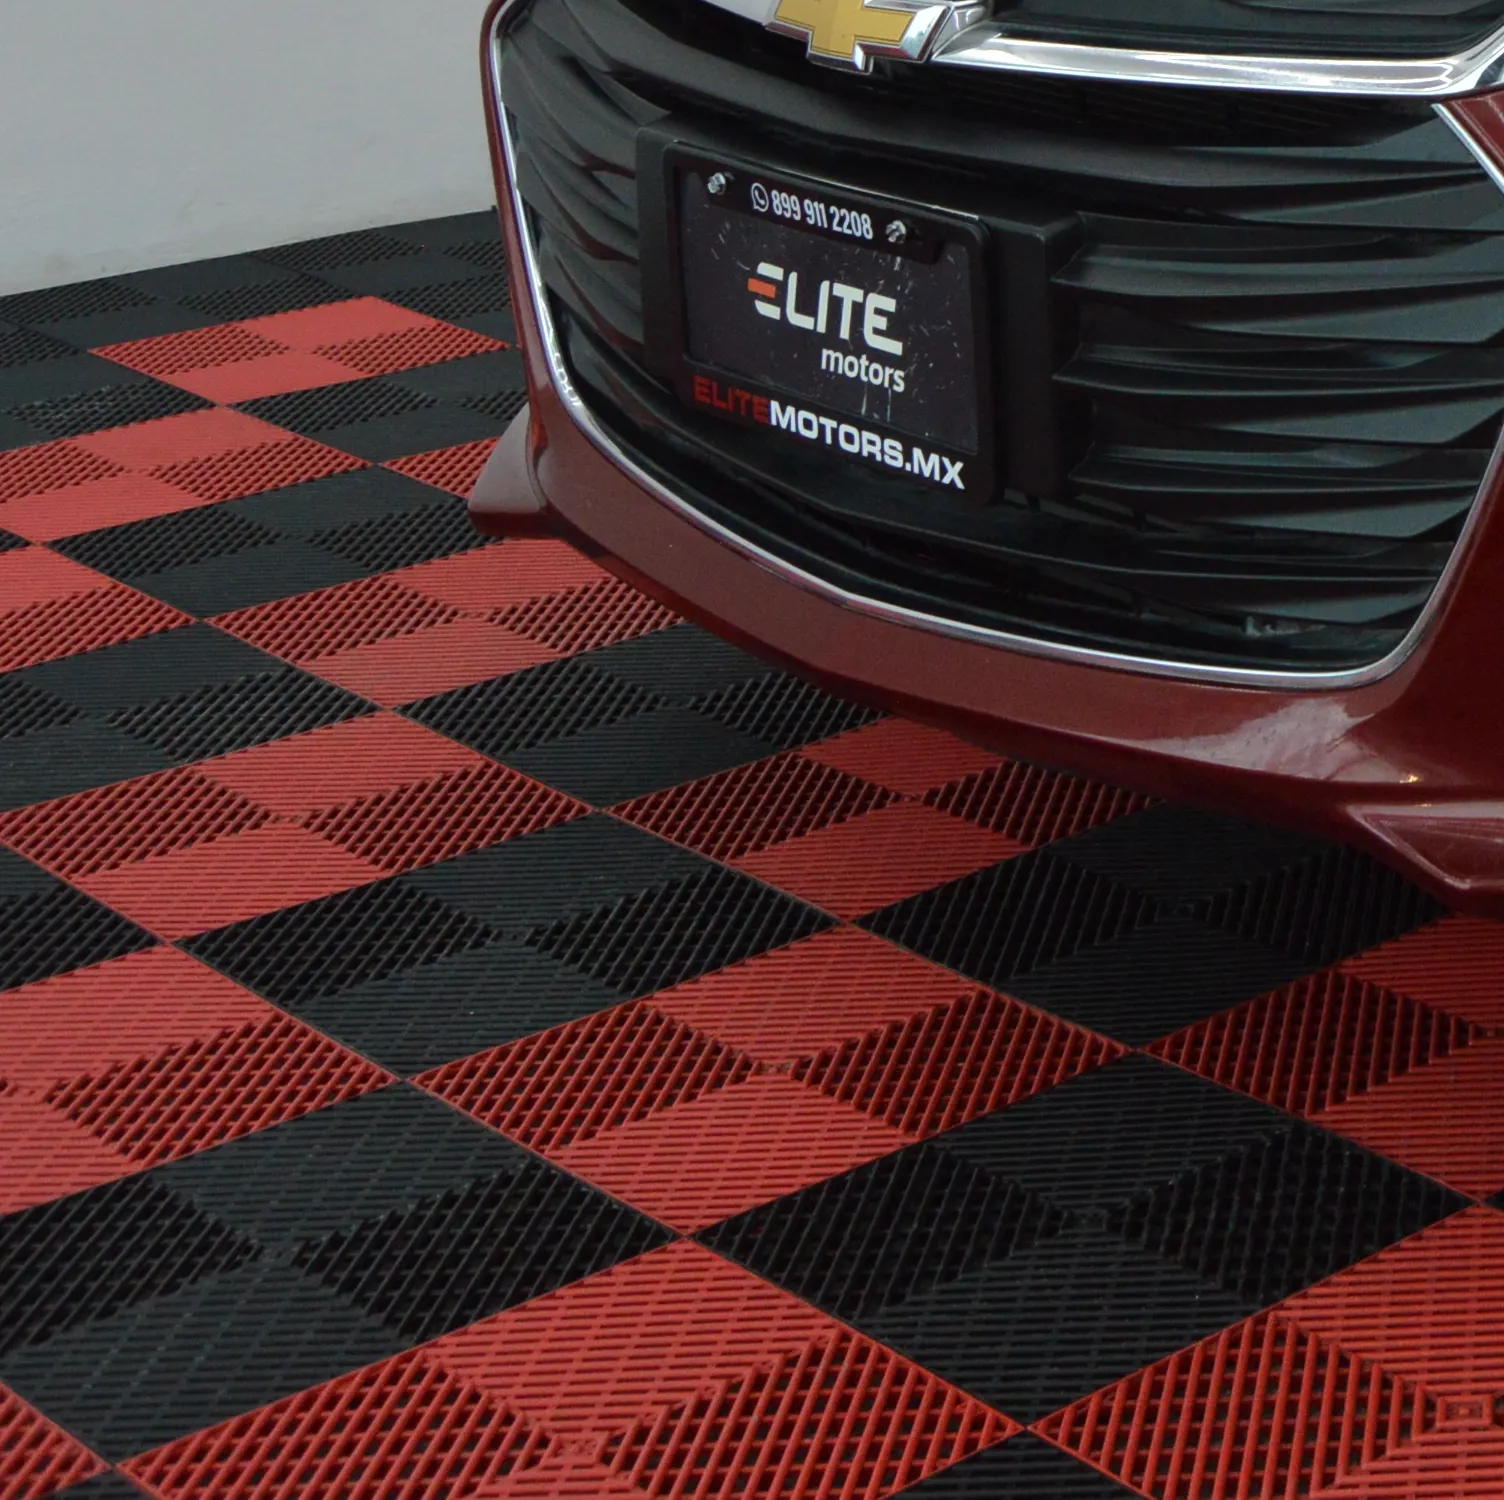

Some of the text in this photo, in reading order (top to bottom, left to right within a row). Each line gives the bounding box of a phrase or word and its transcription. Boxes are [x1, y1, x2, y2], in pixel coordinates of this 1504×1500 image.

[771, 189, 874, 240] 899 911 2208
[748, 262, 903, 356] ELITE
[821, 348, 905, 393] motors
[693, 376, 965, 490] ELITEMOTORS.MX
